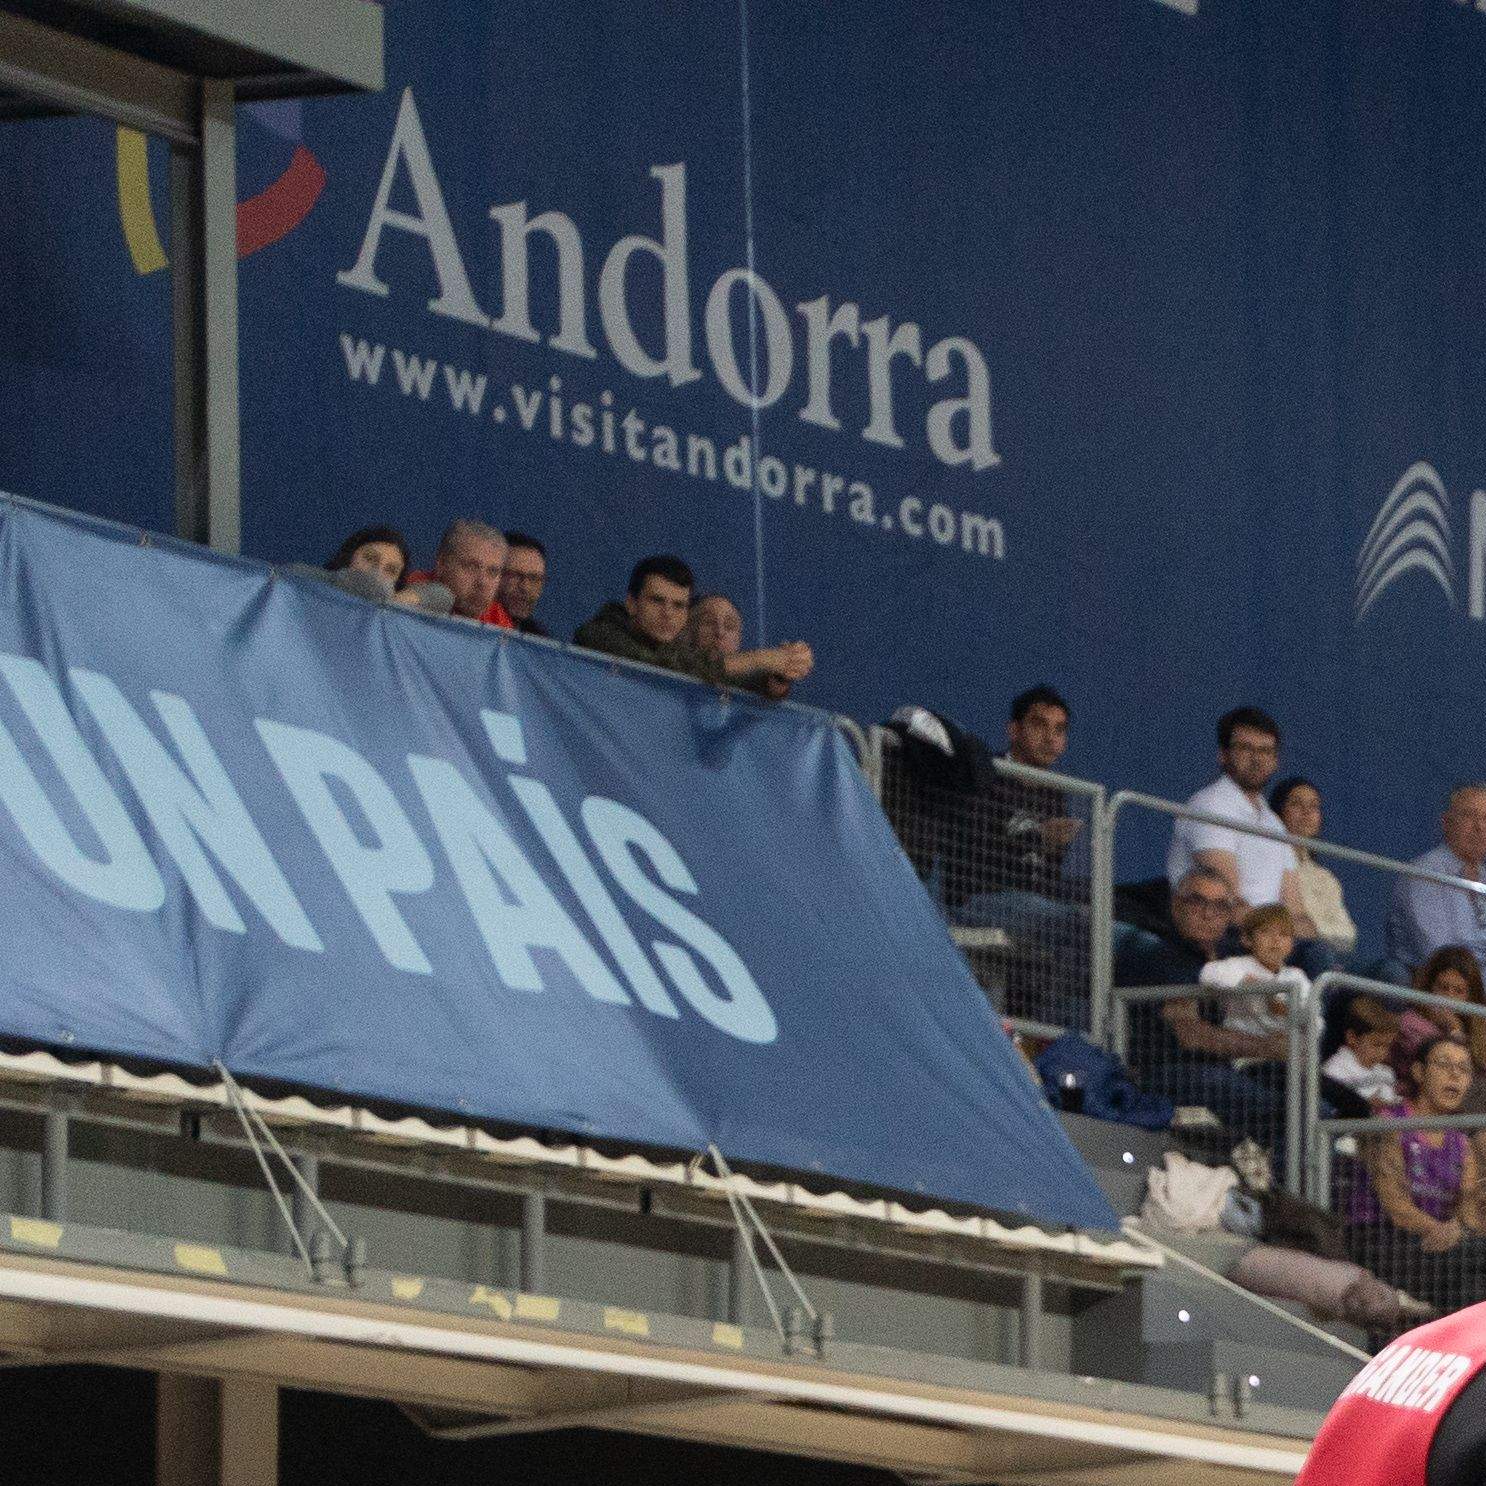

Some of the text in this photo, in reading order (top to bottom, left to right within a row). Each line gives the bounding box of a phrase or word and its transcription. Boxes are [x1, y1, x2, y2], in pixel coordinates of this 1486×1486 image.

[337, 86, 1001, 471] Andorra
[339, 332, 1004, 559] www.visitandorra.com
[255, 708, 780, 1044] PAÍS
